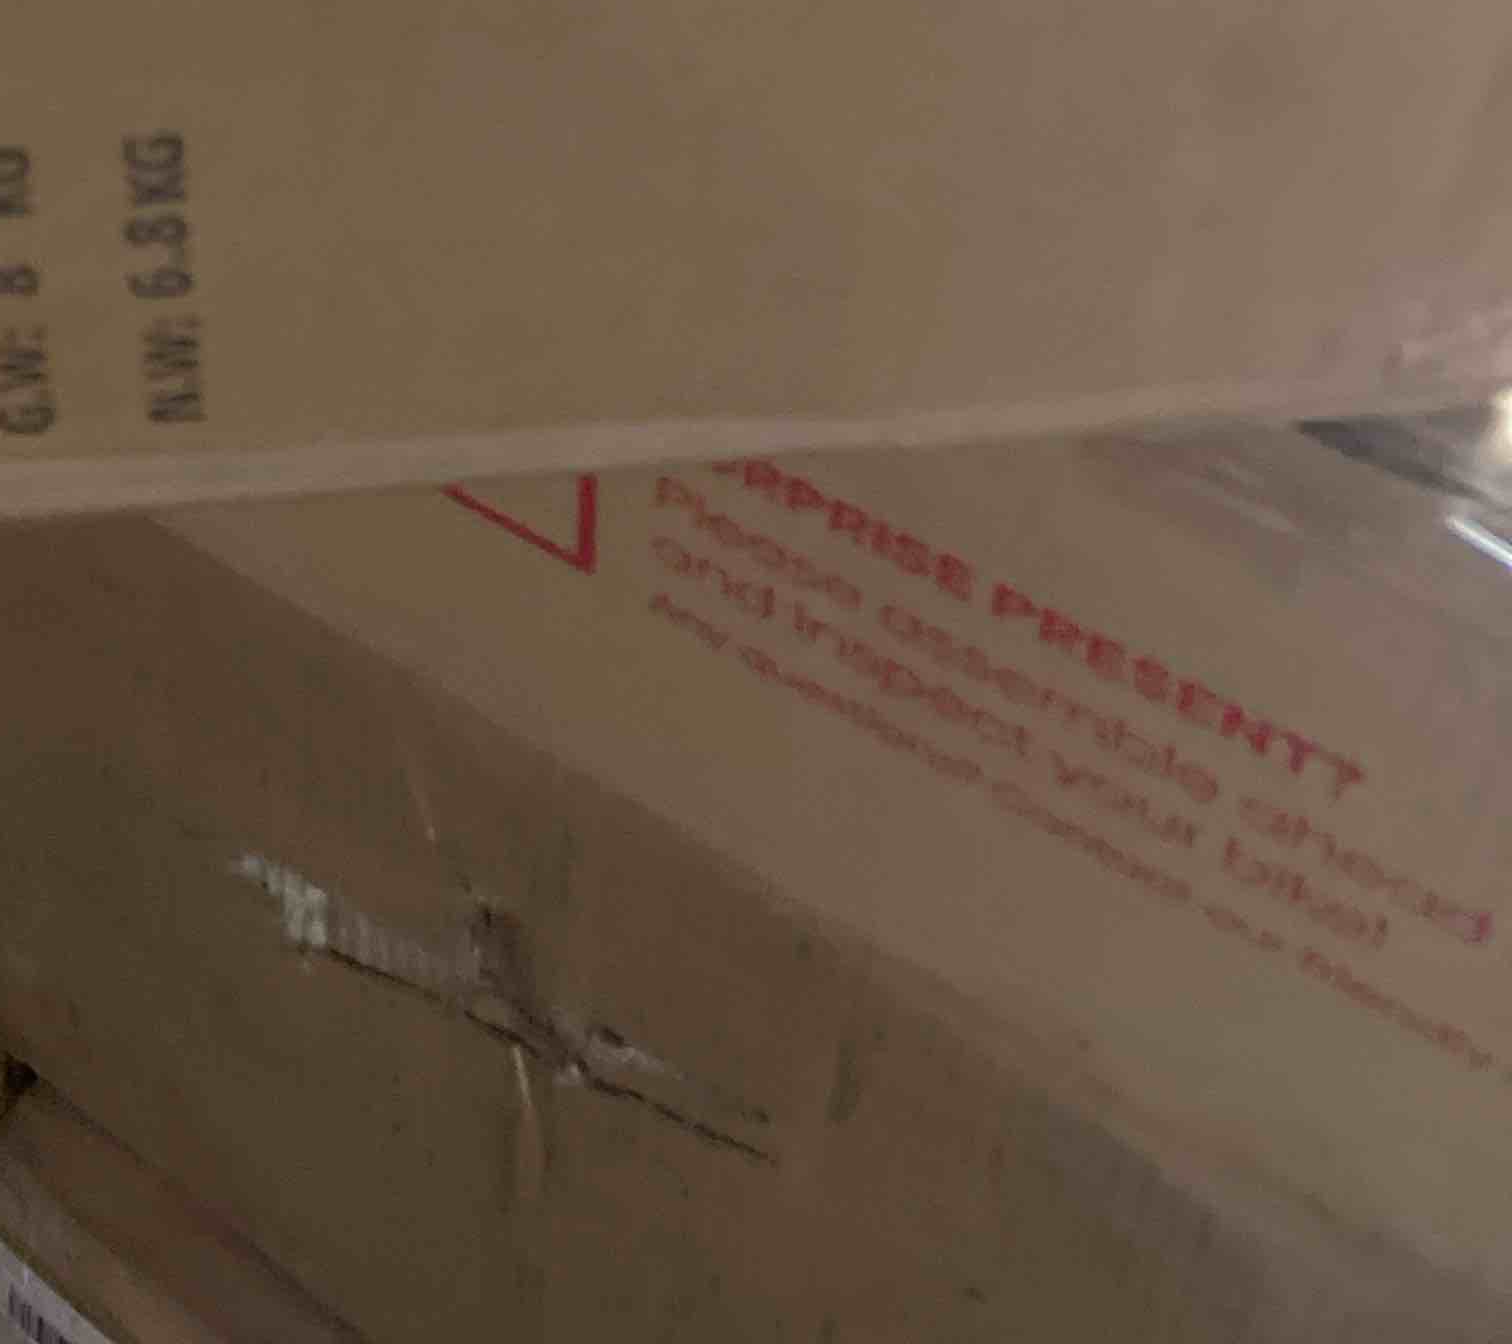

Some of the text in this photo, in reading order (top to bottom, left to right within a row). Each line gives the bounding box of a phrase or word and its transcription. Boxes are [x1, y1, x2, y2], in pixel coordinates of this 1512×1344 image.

[652, 537, 776, 622] and
[656, 474, 863, 607] Please
[992, 582, 1365, 798] PRESENT?
